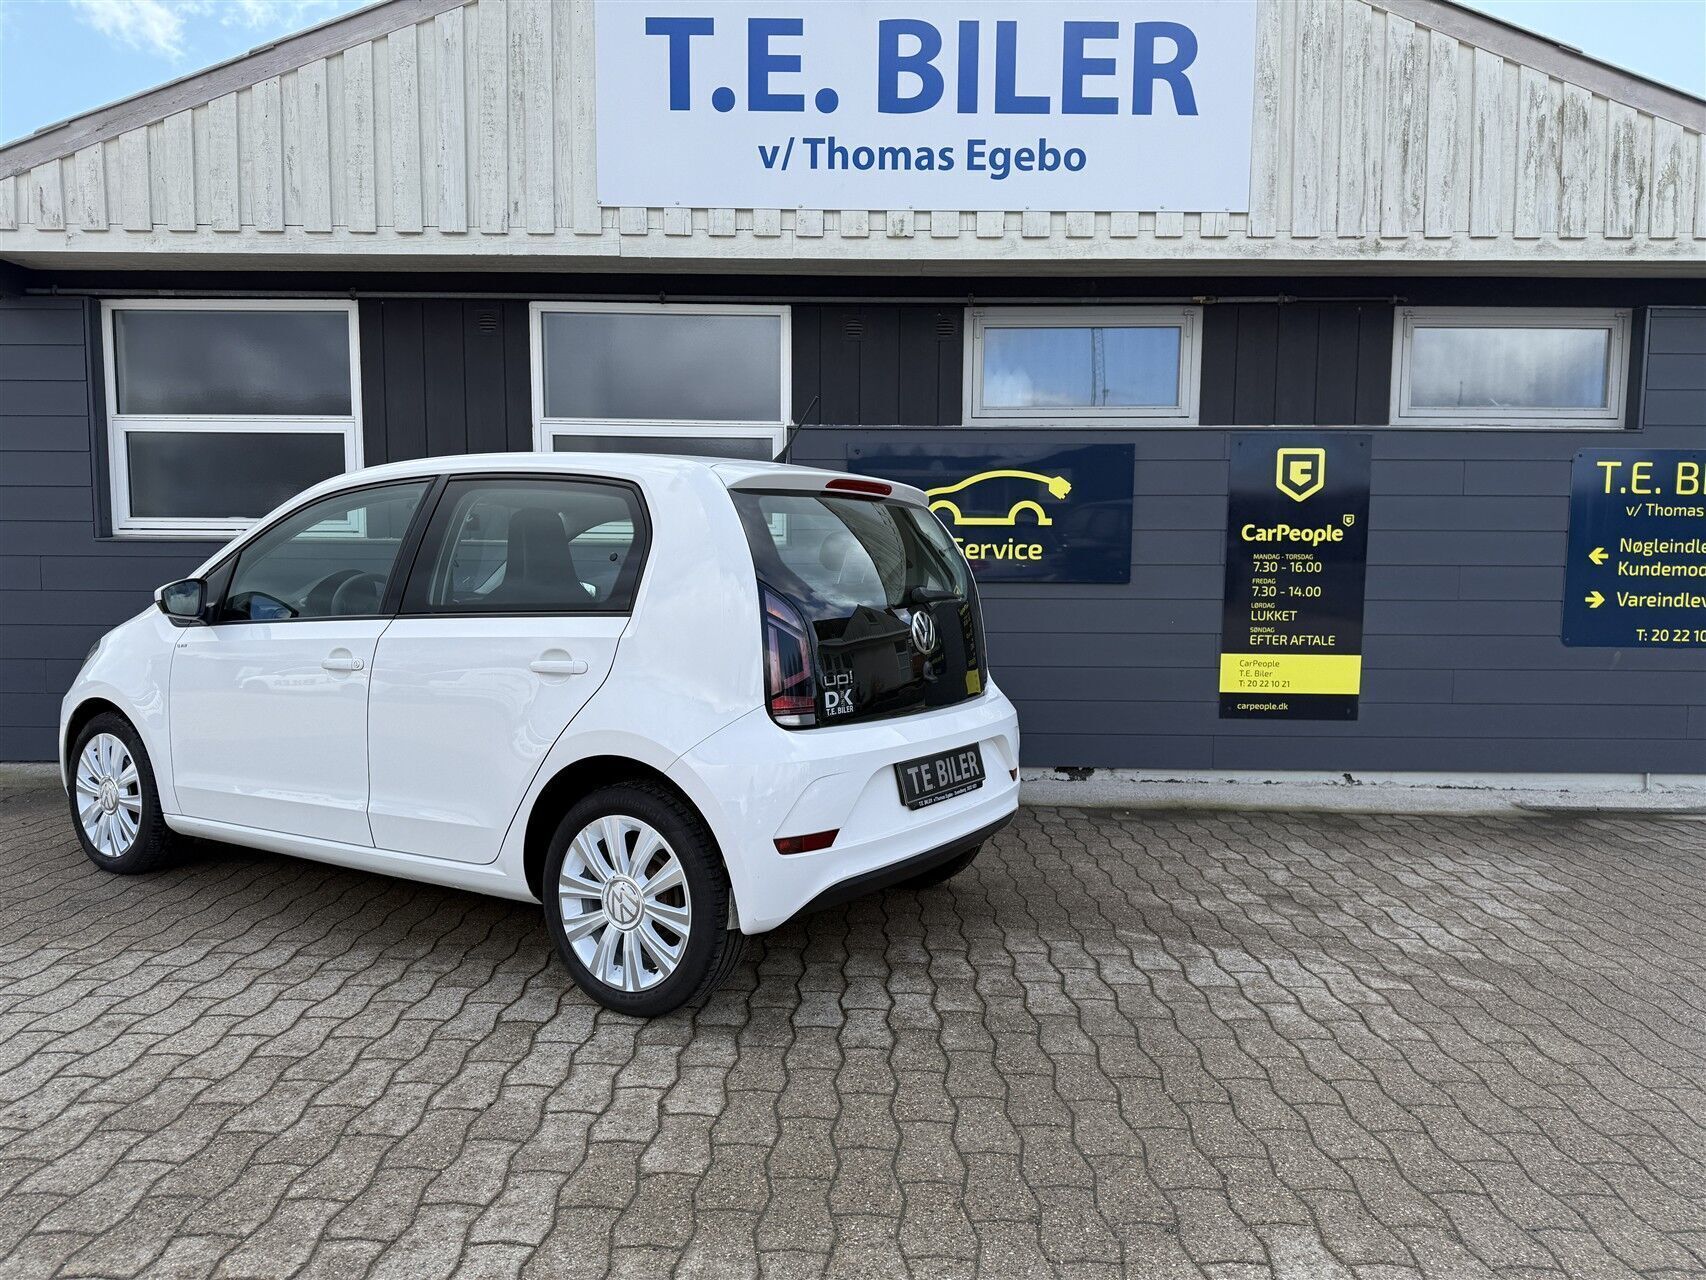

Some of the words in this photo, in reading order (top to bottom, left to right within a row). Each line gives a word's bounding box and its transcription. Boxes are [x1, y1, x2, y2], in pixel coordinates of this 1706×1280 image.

[645, 16, 839, 113] T.E.
[877, 19, 1199, 116] BILER
[758, 138, 794, 171] v/
[802, 138, 955, 171] Thomas
[966, 139, 1087, 180] Egebo
[1597, 461, 1661, 494] T.E.
[1626, 503, 1643, 517] v/
[1646, 503, 1704, 517] Thomas
[1241, 523, 1344, 547] CarPeople
[1253, 561, 1278, 573] 7.30
[1289, 561, 1322, 573] 16.00
[1252, 585, 1277, 597] 7.30
[1288, 585, 1322, 597] 14.00
[1251, 610, 1298, 621] LUKKET
[1249, 634, 1288, 646] EFTER
[1290, 635, 1336, 646] AFTALE
[1637, 629, 1648, 642] T:
[1652, 629, 1669, 642] 20
[1673, 630, 1690, 642] 22
[1239, 659, 1280, 669] CarPeople
[1239, 670, 1253, 678] T.E.
[1254, 670, 1273, 678] Biler
[1239, 680, 1246, 688] T:
[1247, 680, 1258, 688] 20
[1259, 680, 1269, 688] 22
[1271, 680, 1280, 688] 10
[1281, 680, 1291, 688] 21
[837, 705, 854, 715] BILER
[1236, 702, 1289, 711] carpeople.dk
[935, 751, 980, 788] BILER
